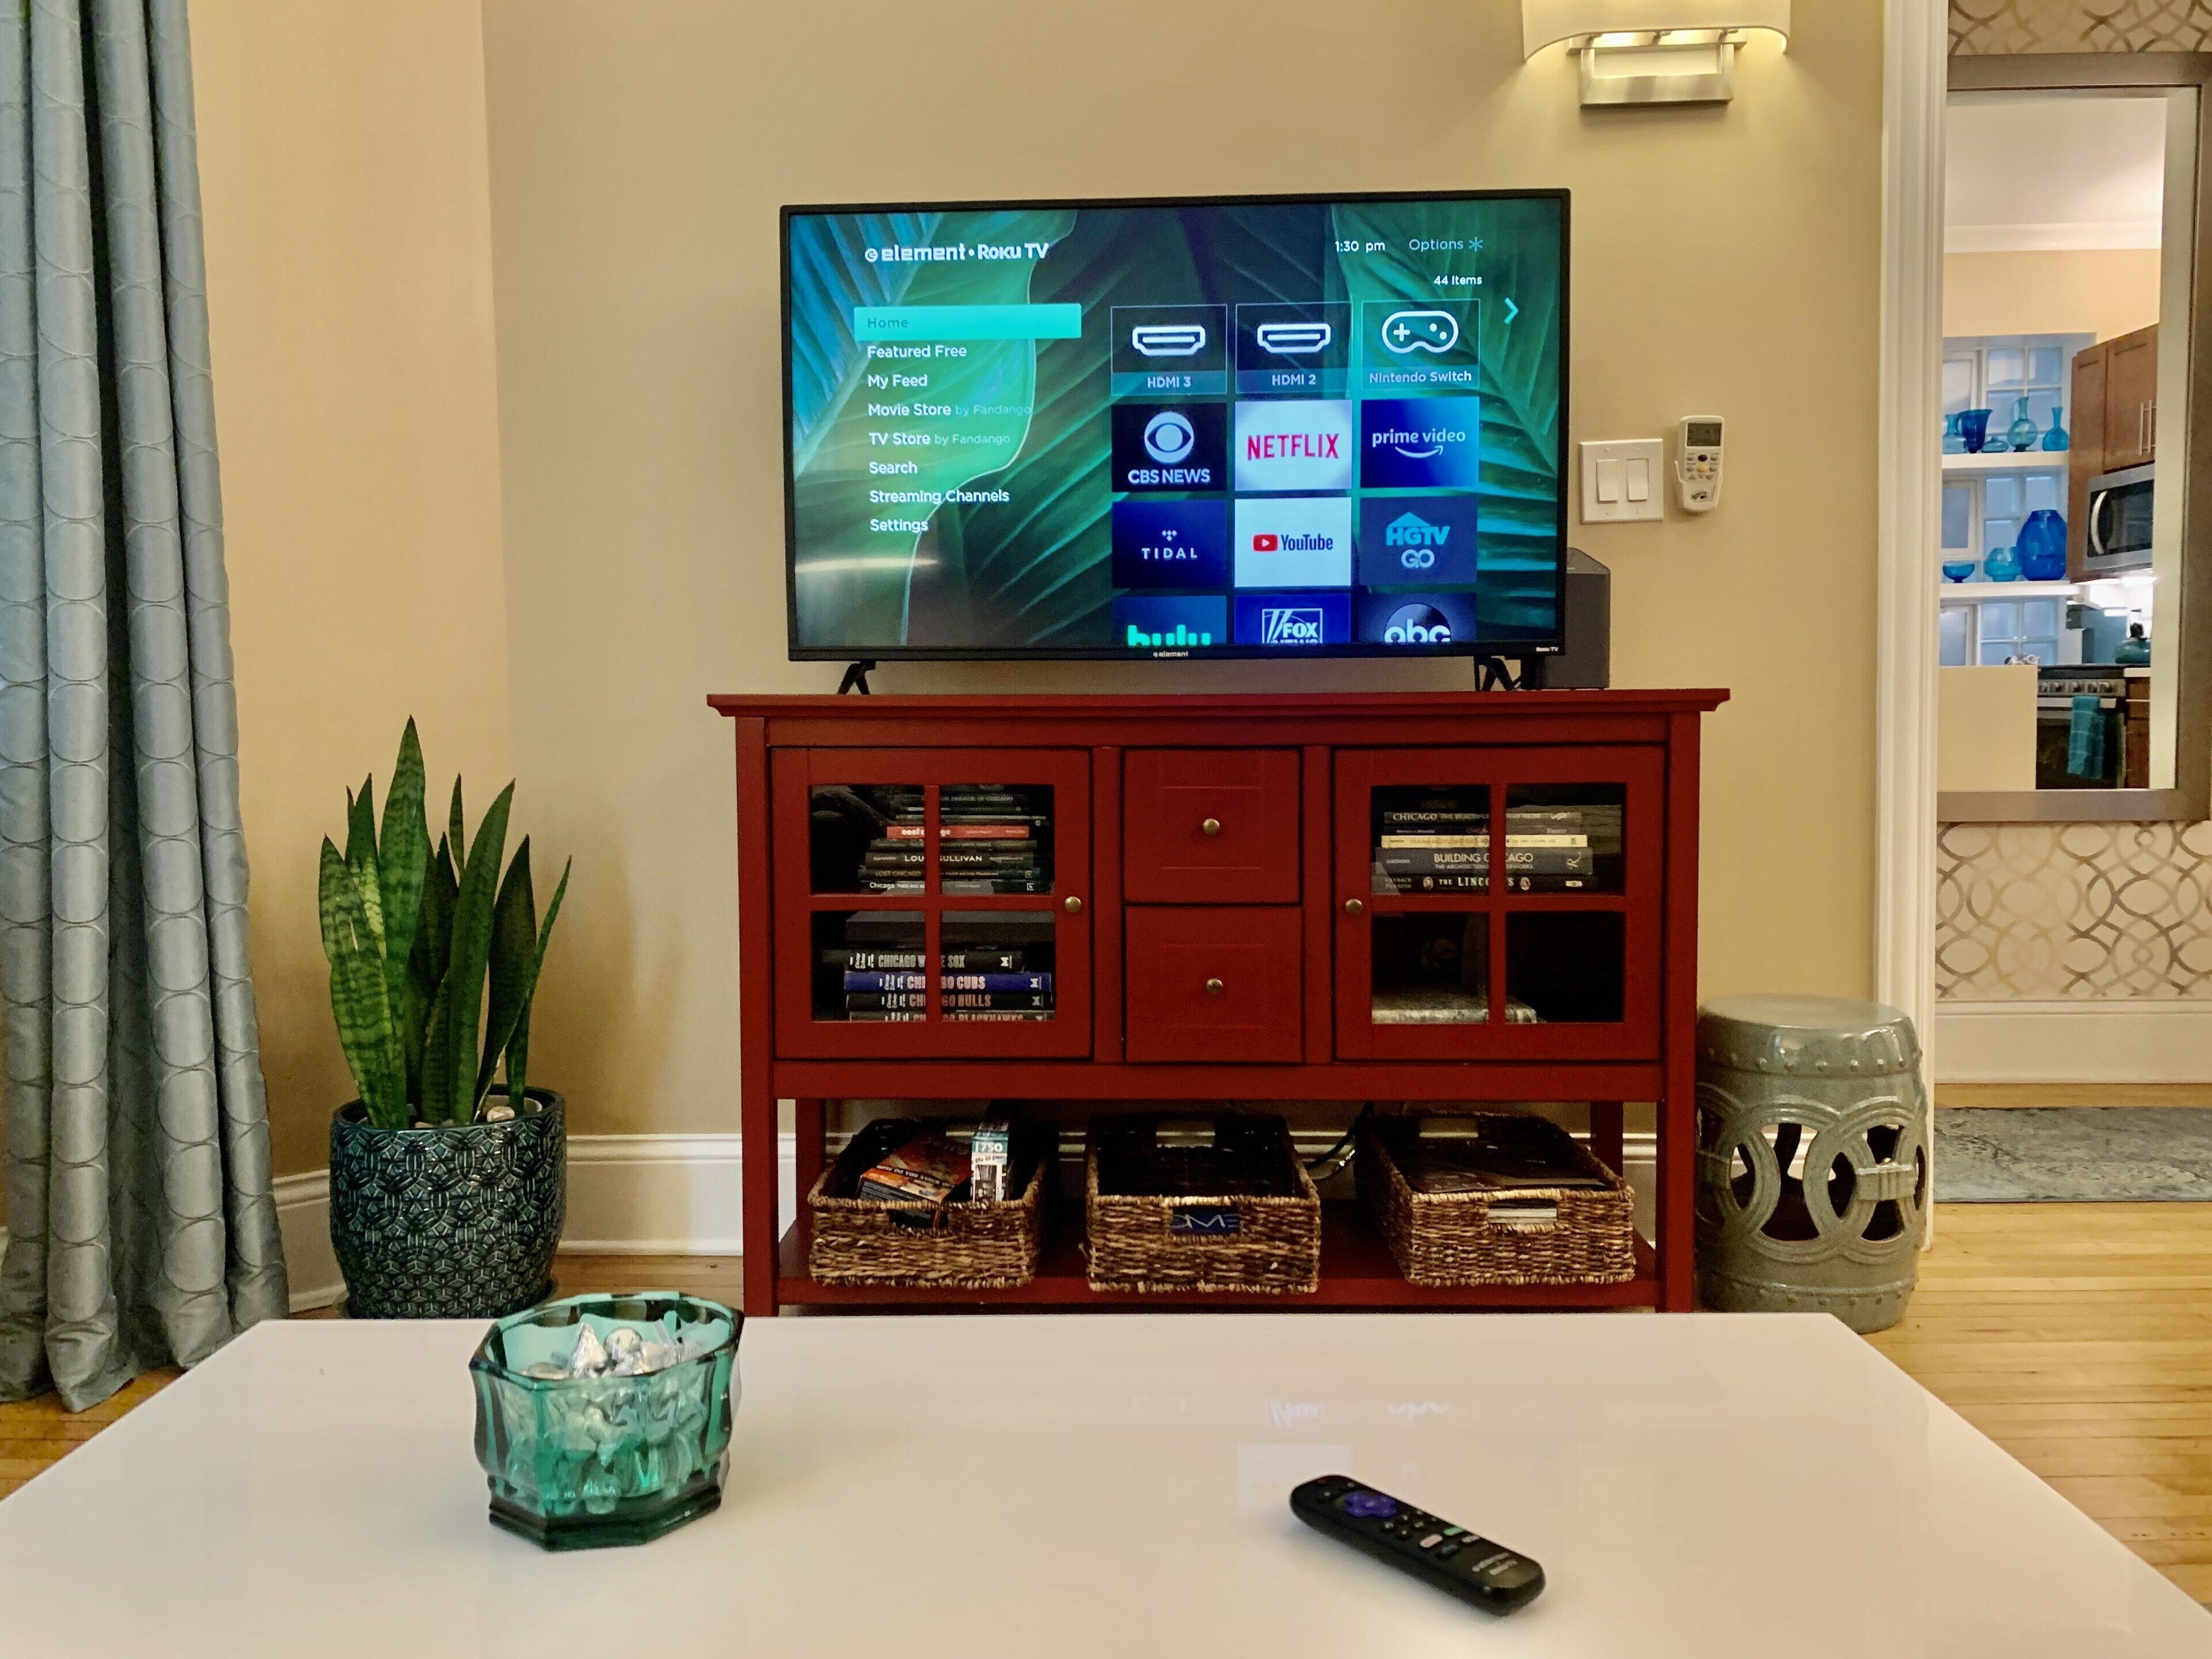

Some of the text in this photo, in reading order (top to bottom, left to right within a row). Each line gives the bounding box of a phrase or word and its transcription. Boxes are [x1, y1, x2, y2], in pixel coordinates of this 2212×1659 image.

[881, 243, 1050, 262] element Roku TV
[1335, 241, 1385, 255] 1:30 pm
[1409, 238, 1464, 253] Options
[1434, 274, 1483, 286] 44 Items
[868, 317, 908, 329] Home
[868, 344, 967, 359] Featured Free
[868, 374, 928, 390] My Feed
[1147, 376, 1192, 389] HDMI 3
[1271, 374, 1316, 387] HDMI 2
[1369, 370, 1472, 384] Nintendo Switch
[868, 403, 1031, 419] Movie Store by Fandango
[869, 432, 1010, 448] TV Store by Fandango
[1372, 428, 1466, 448] prime video
[1247, 433, 1340, 461] NETFLIX
[869, 461, 918, 475] Search
[1127, 469, 1210, 485] CBS NEWS
[870, 489, 1010, 505] Streaming Channels
[870, 518, 929, 533] Settings
[1281, 533, 1334, 551] YouTube
[1386, 525, 1450, 546] HGTV
[1141, 547, 1198, 560] TIDAL
[1400, 548, 1435, 569] GO
[1282, 622, 1319, 638] FOX
[1384, 618, 1451, 643] abc
[1392, 813, 1437, 821] CHICAGO
[1434, 853, 1481, 863] BUILDING
[869, 882, 895, 891] Chicago
[878, 954, 916, 968] CHICAGO
[948, 955, 965, 968] SOX
[957, 975, 986, 990] CUBS
[958, 994, 991, 1007] BULLS
